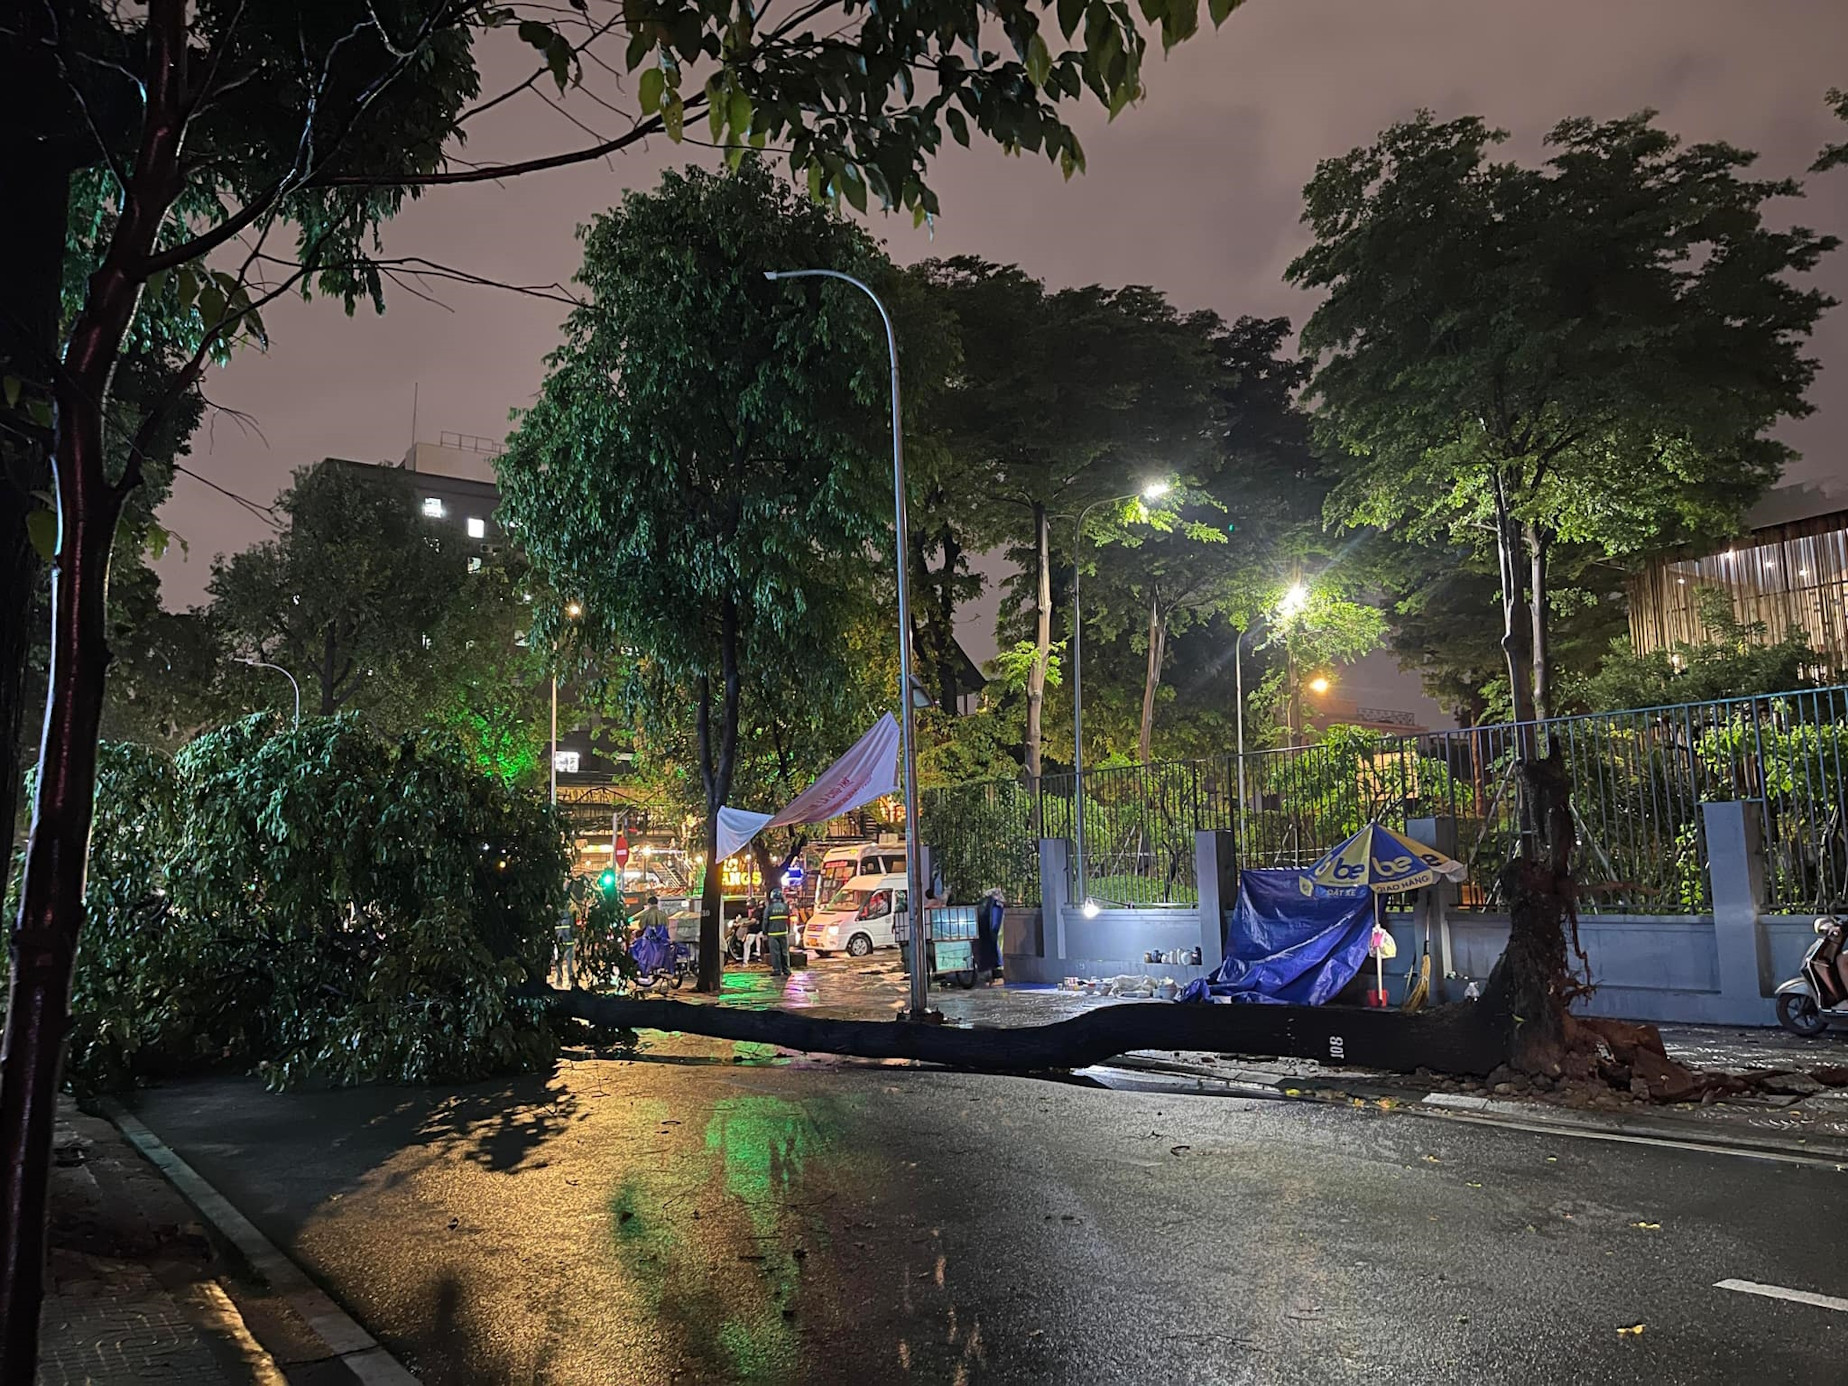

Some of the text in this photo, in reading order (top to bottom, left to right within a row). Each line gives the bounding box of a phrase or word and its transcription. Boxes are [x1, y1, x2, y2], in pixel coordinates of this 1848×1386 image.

[1333, 857, 1365, 880] be
[1371, 856, 1413, 877] be
[1329, 1036, 1345, 1059] 108
